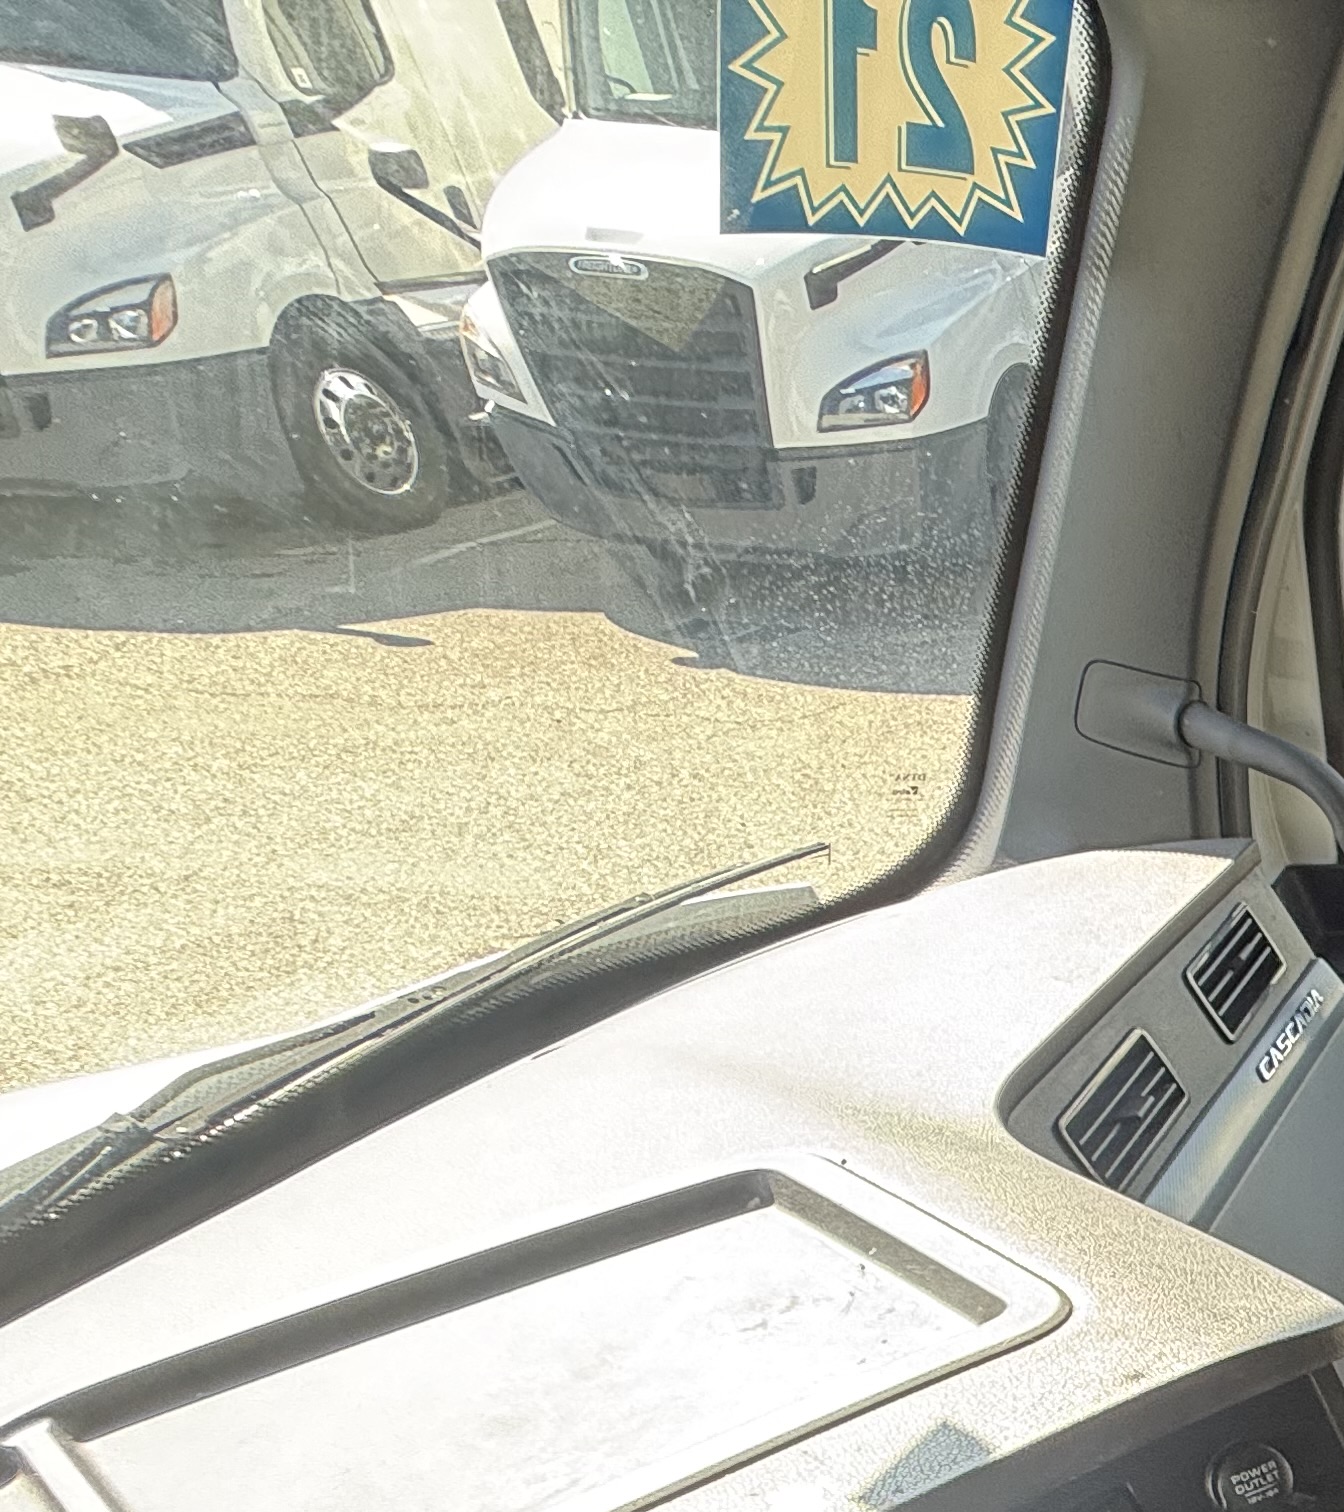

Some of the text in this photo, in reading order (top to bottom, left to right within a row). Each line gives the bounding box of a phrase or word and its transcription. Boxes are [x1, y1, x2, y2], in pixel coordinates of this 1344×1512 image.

[1258, 988, 1324, 1081] CASCADIA
[1230, 1460, 1277, 1485] POWER
[1234, 1470, 1279, 1495] OUTLET
